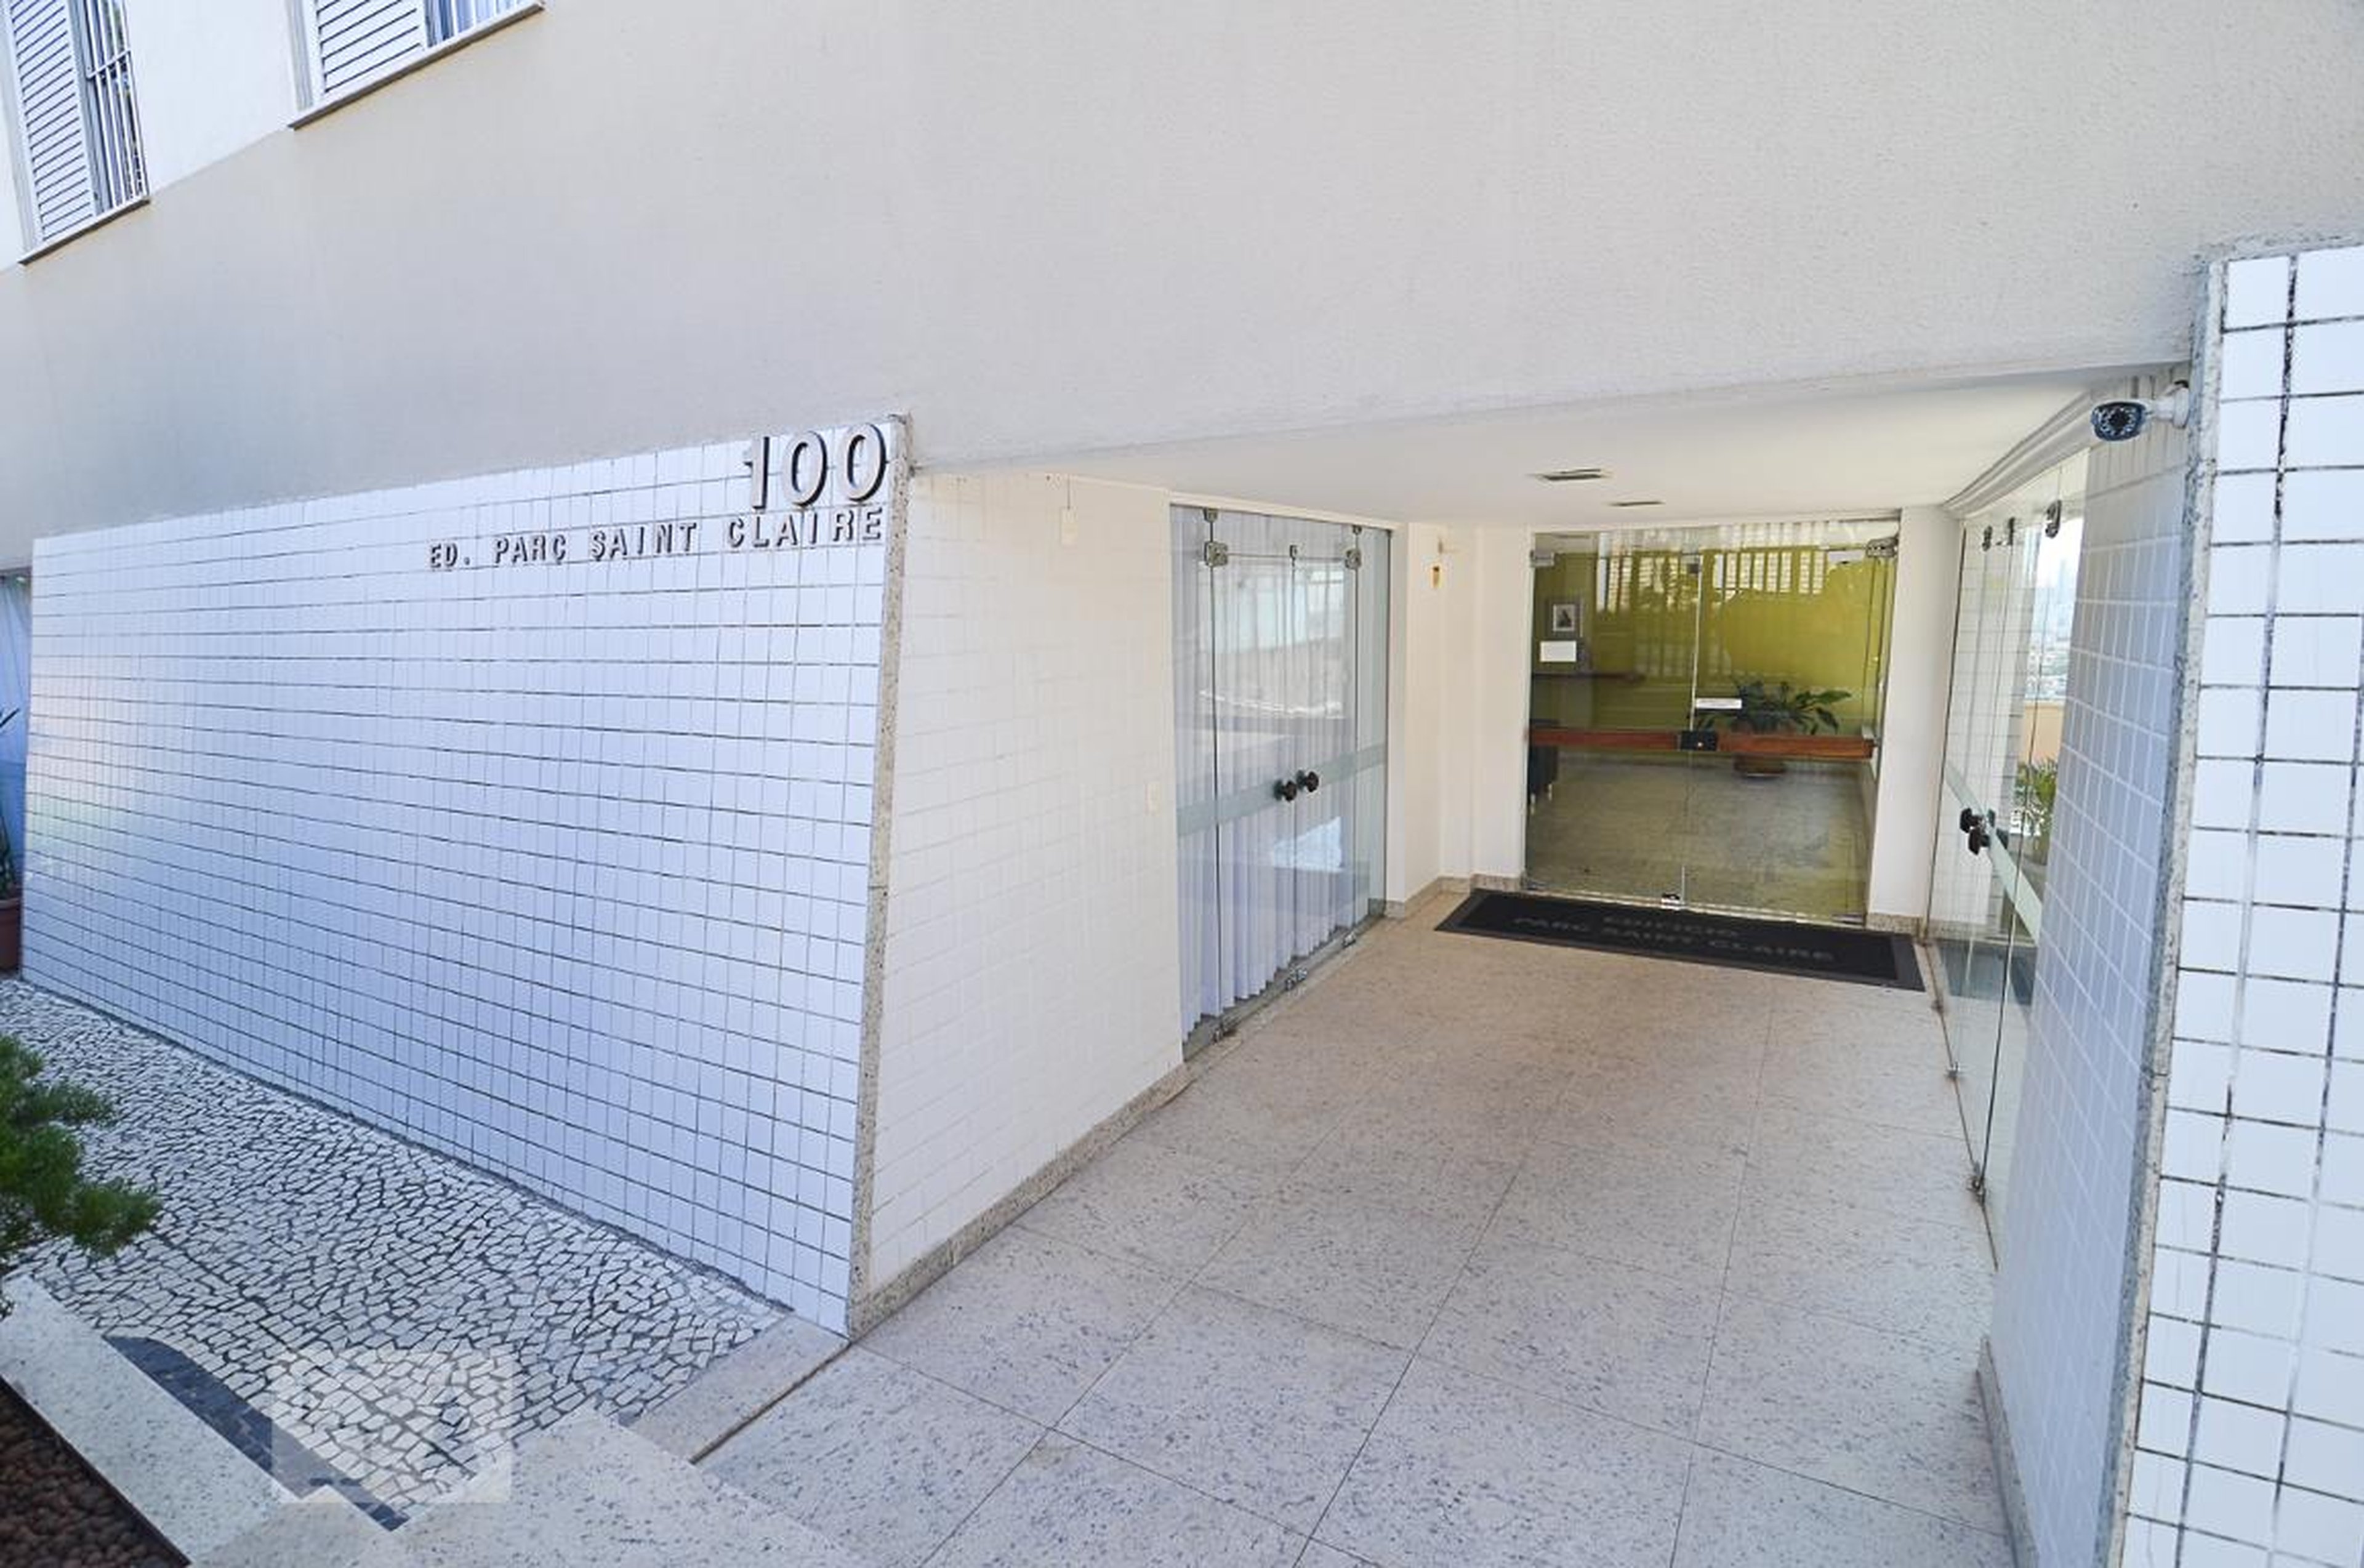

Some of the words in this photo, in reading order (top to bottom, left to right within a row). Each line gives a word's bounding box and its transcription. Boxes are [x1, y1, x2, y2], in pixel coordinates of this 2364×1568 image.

[746, 424, 887, 509] 100
[428, 542, 470, 569] ED.
[493, 535, 567, 565] PARC
[590, 522, 698, 561] SAINT
[729, 509, 883, 548] CLAIRE
